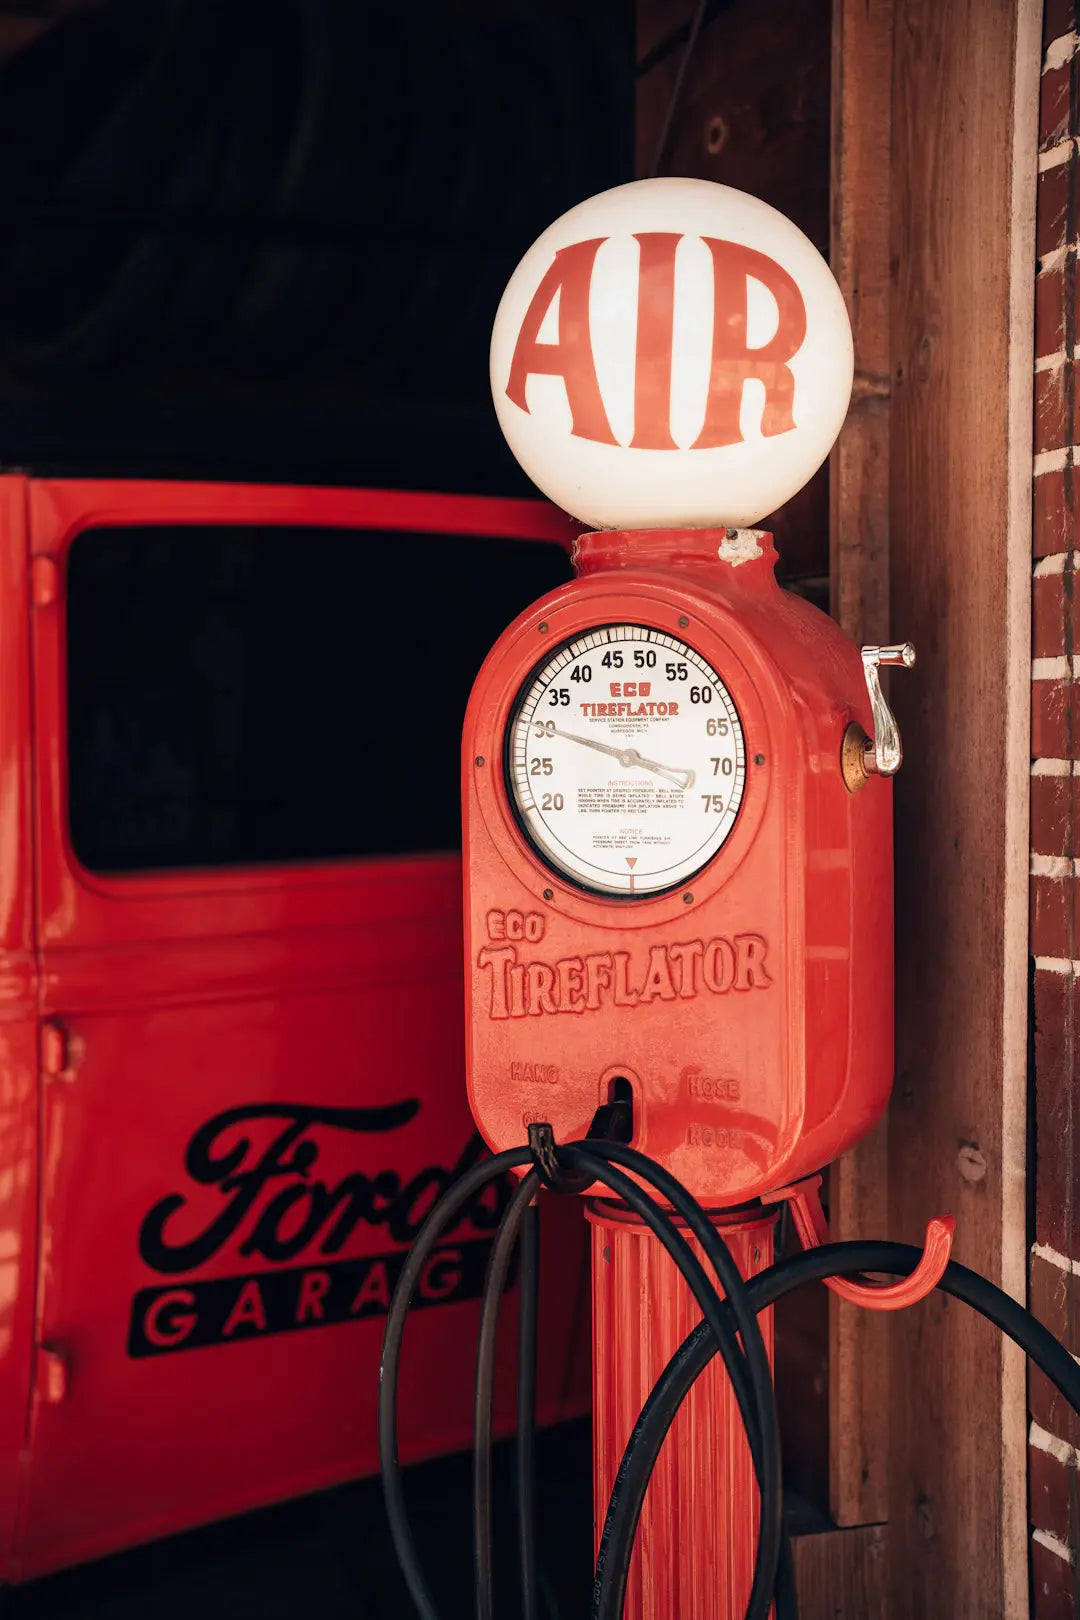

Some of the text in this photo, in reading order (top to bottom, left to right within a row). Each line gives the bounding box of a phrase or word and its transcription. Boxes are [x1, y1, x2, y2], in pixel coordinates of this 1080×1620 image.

[505, 232, 807, 450] AIR
[602, 651, 624, 668] 45
[633, 650, 656, 668] 50
[570, 665, 592, 683] 40
[665, 663, 688, 681] 55
[548, 689, 570, 706] 35
[609, 682, 651, 697] ECO
[690, 686, 712, 704] 60
[580, 702, 679, 717] TIREFLATOR
[534, 720, 556, 738] 30
[706, 718, 729, 736] 65
[530, 758, 553, 776] 25
[710, 758, 733, 776] 70
[541, 793, 564, 811] 20
[701, 795, 723, 813] 75
[486, 908, 545, 943] ECO
[477, 933, 773, 1020] TIREFLATOR
[511, 1061, 559, 1084] HANG
[688, 1074, 741, 1099] HOSE
[686, 1124, 744, 1150] HOOK
[144, 1249, 464, 1347] GARAG
